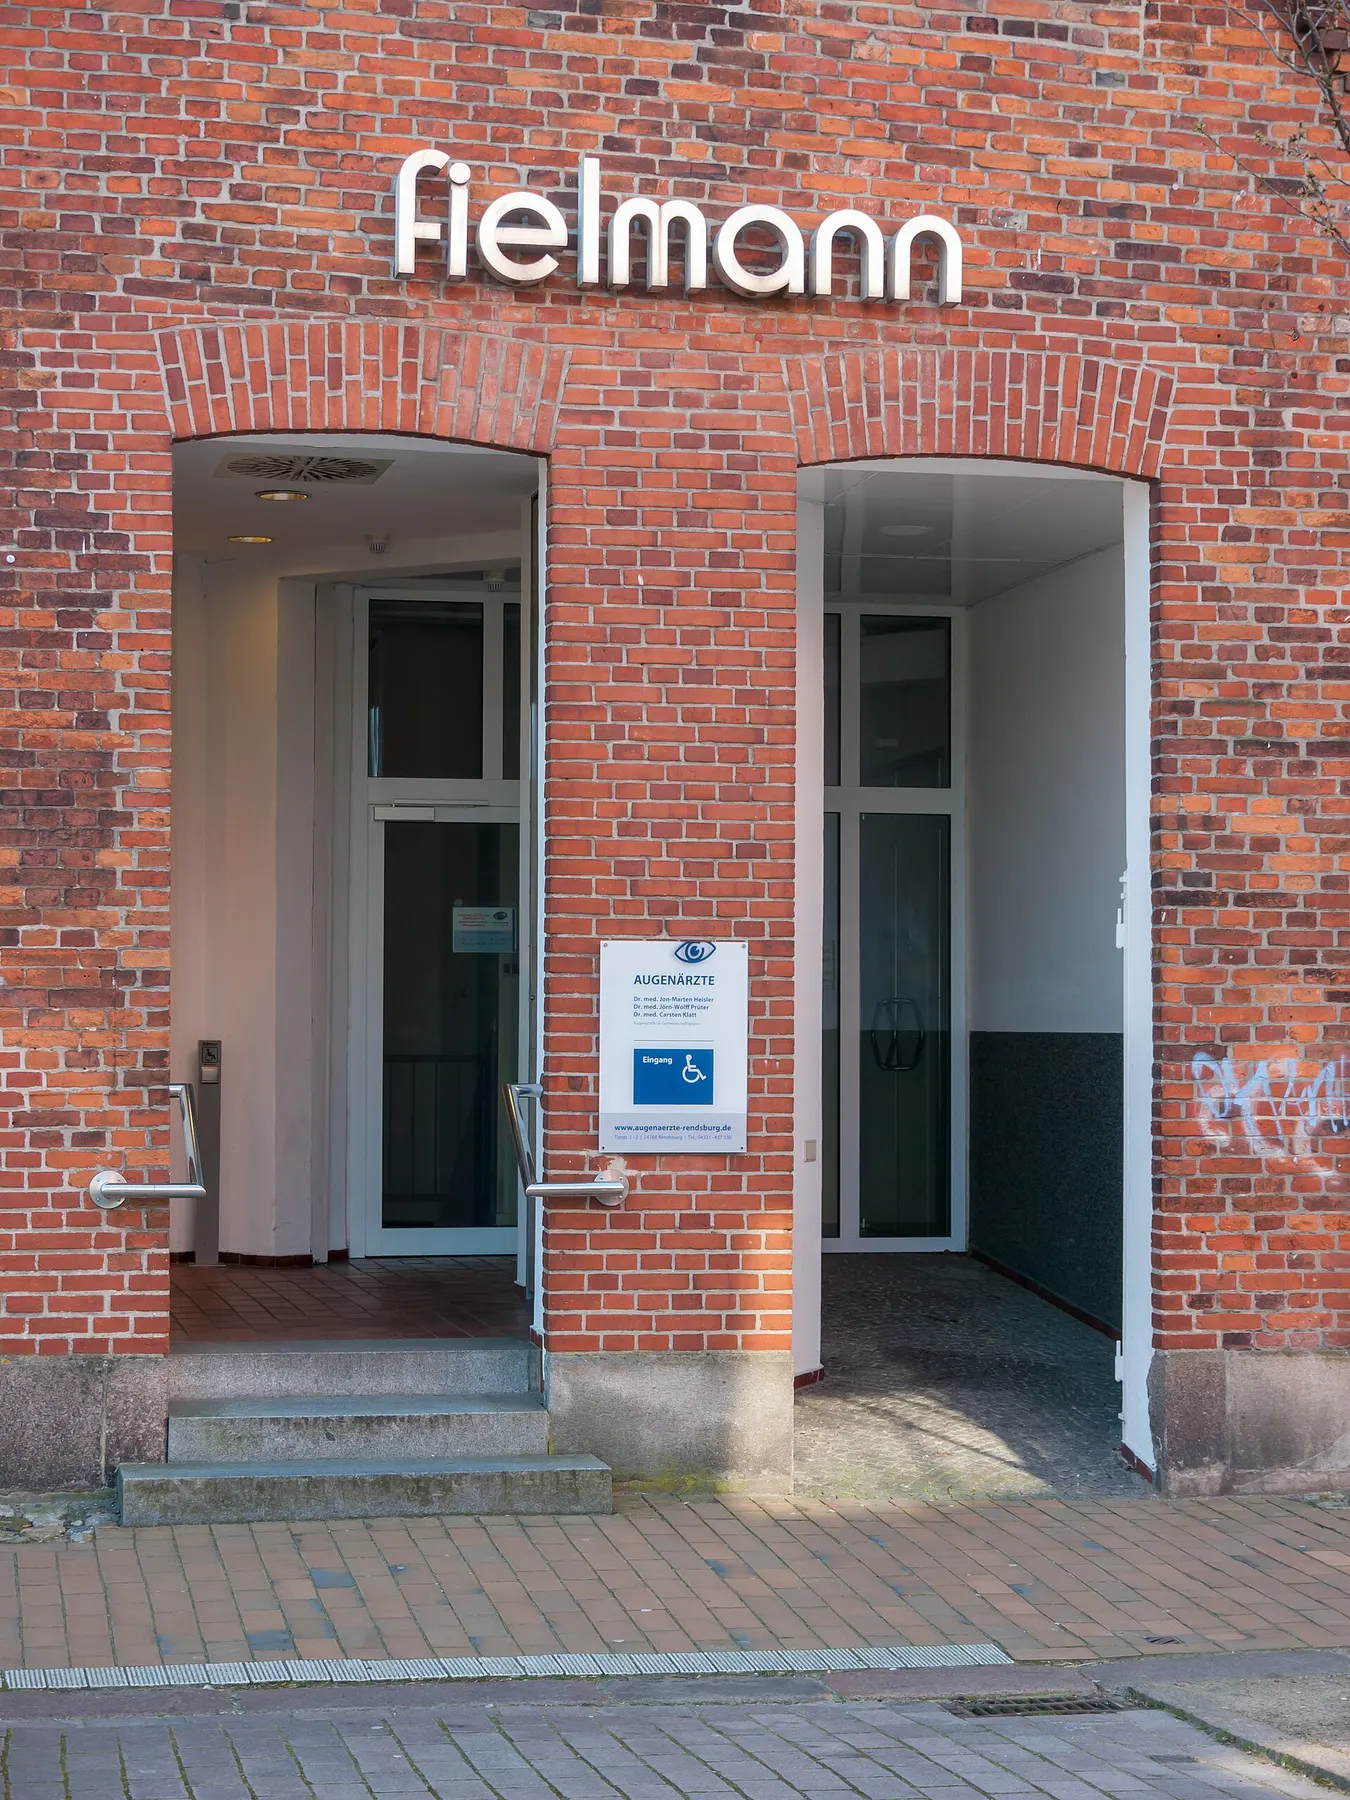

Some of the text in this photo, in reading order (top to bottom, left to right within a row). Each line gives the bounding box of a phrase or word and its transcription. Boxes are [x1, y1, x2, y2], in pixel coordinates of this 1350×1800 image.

[394, 148, 963, 307] fielmann
[633, 973, 715, 986] AUGENÄRZTE
[642, 1056, 673, 1065] Eingang
[614, 1124, 732, 1133] www.augenaerzte-rendsburg.de
